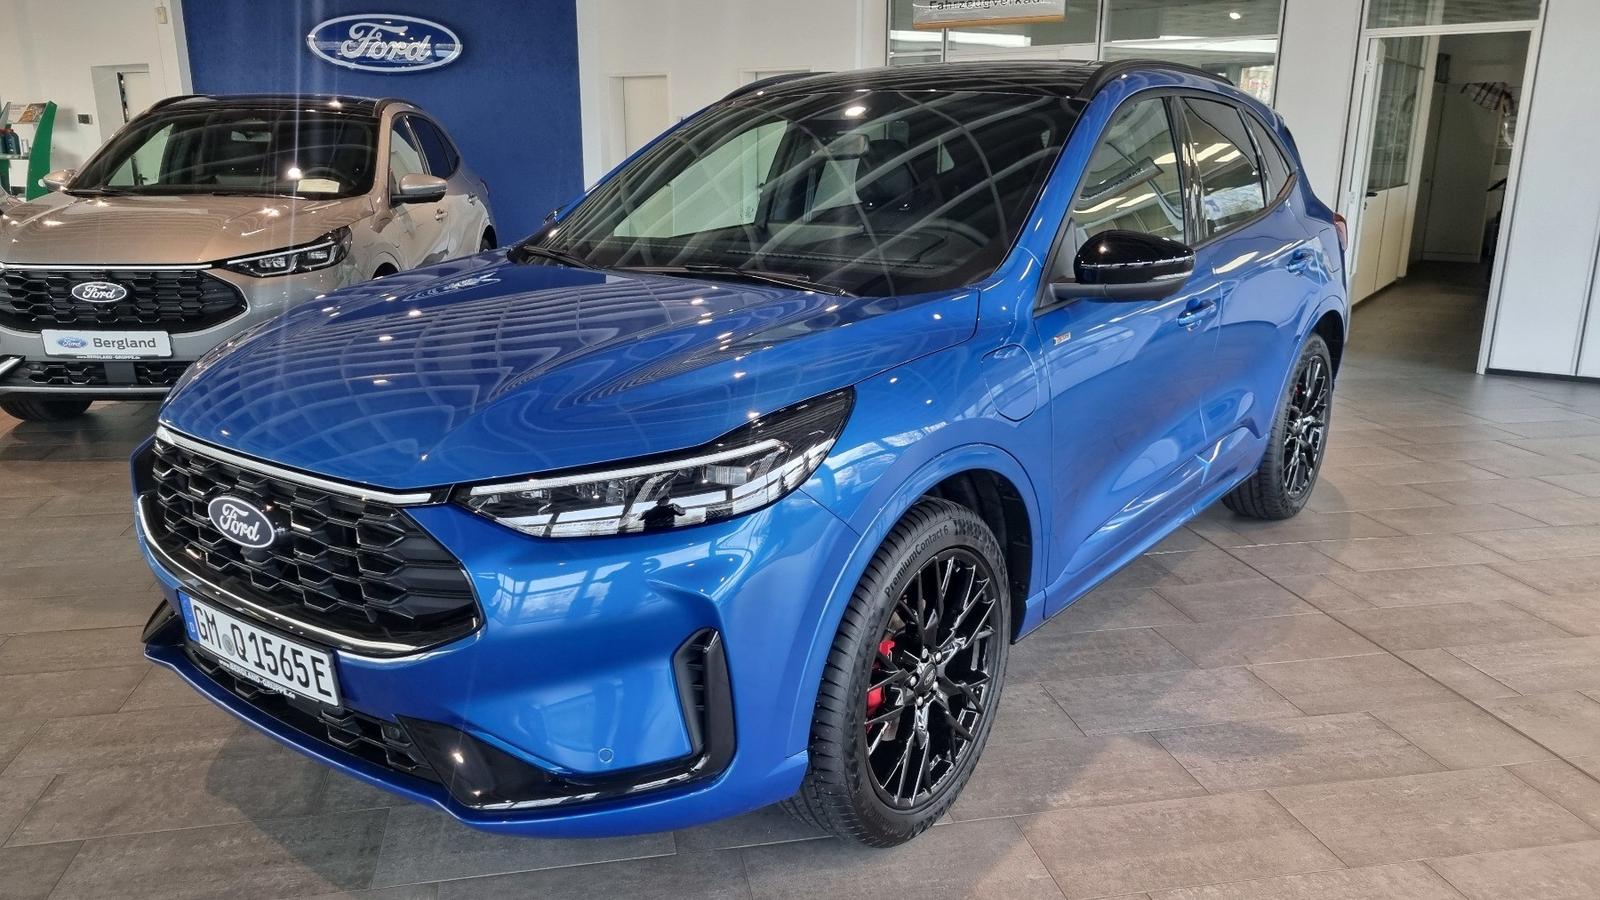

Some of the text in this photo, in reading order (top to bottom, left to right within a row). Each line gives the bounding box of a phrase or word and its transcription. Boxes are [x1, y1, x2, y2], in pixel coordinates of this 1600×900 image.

[929, 0, 1044, 10] Fahrzeugverkau
[340, 22, 432, 62] Ford
[82, 284, 117, 299] Ford
[93, 337, 157, 350] Bergland
[220, 503, 260, 542] Ford
[884, 524, 949, 598] PremiumContact 6
[193, 604, 222, 650] GM
